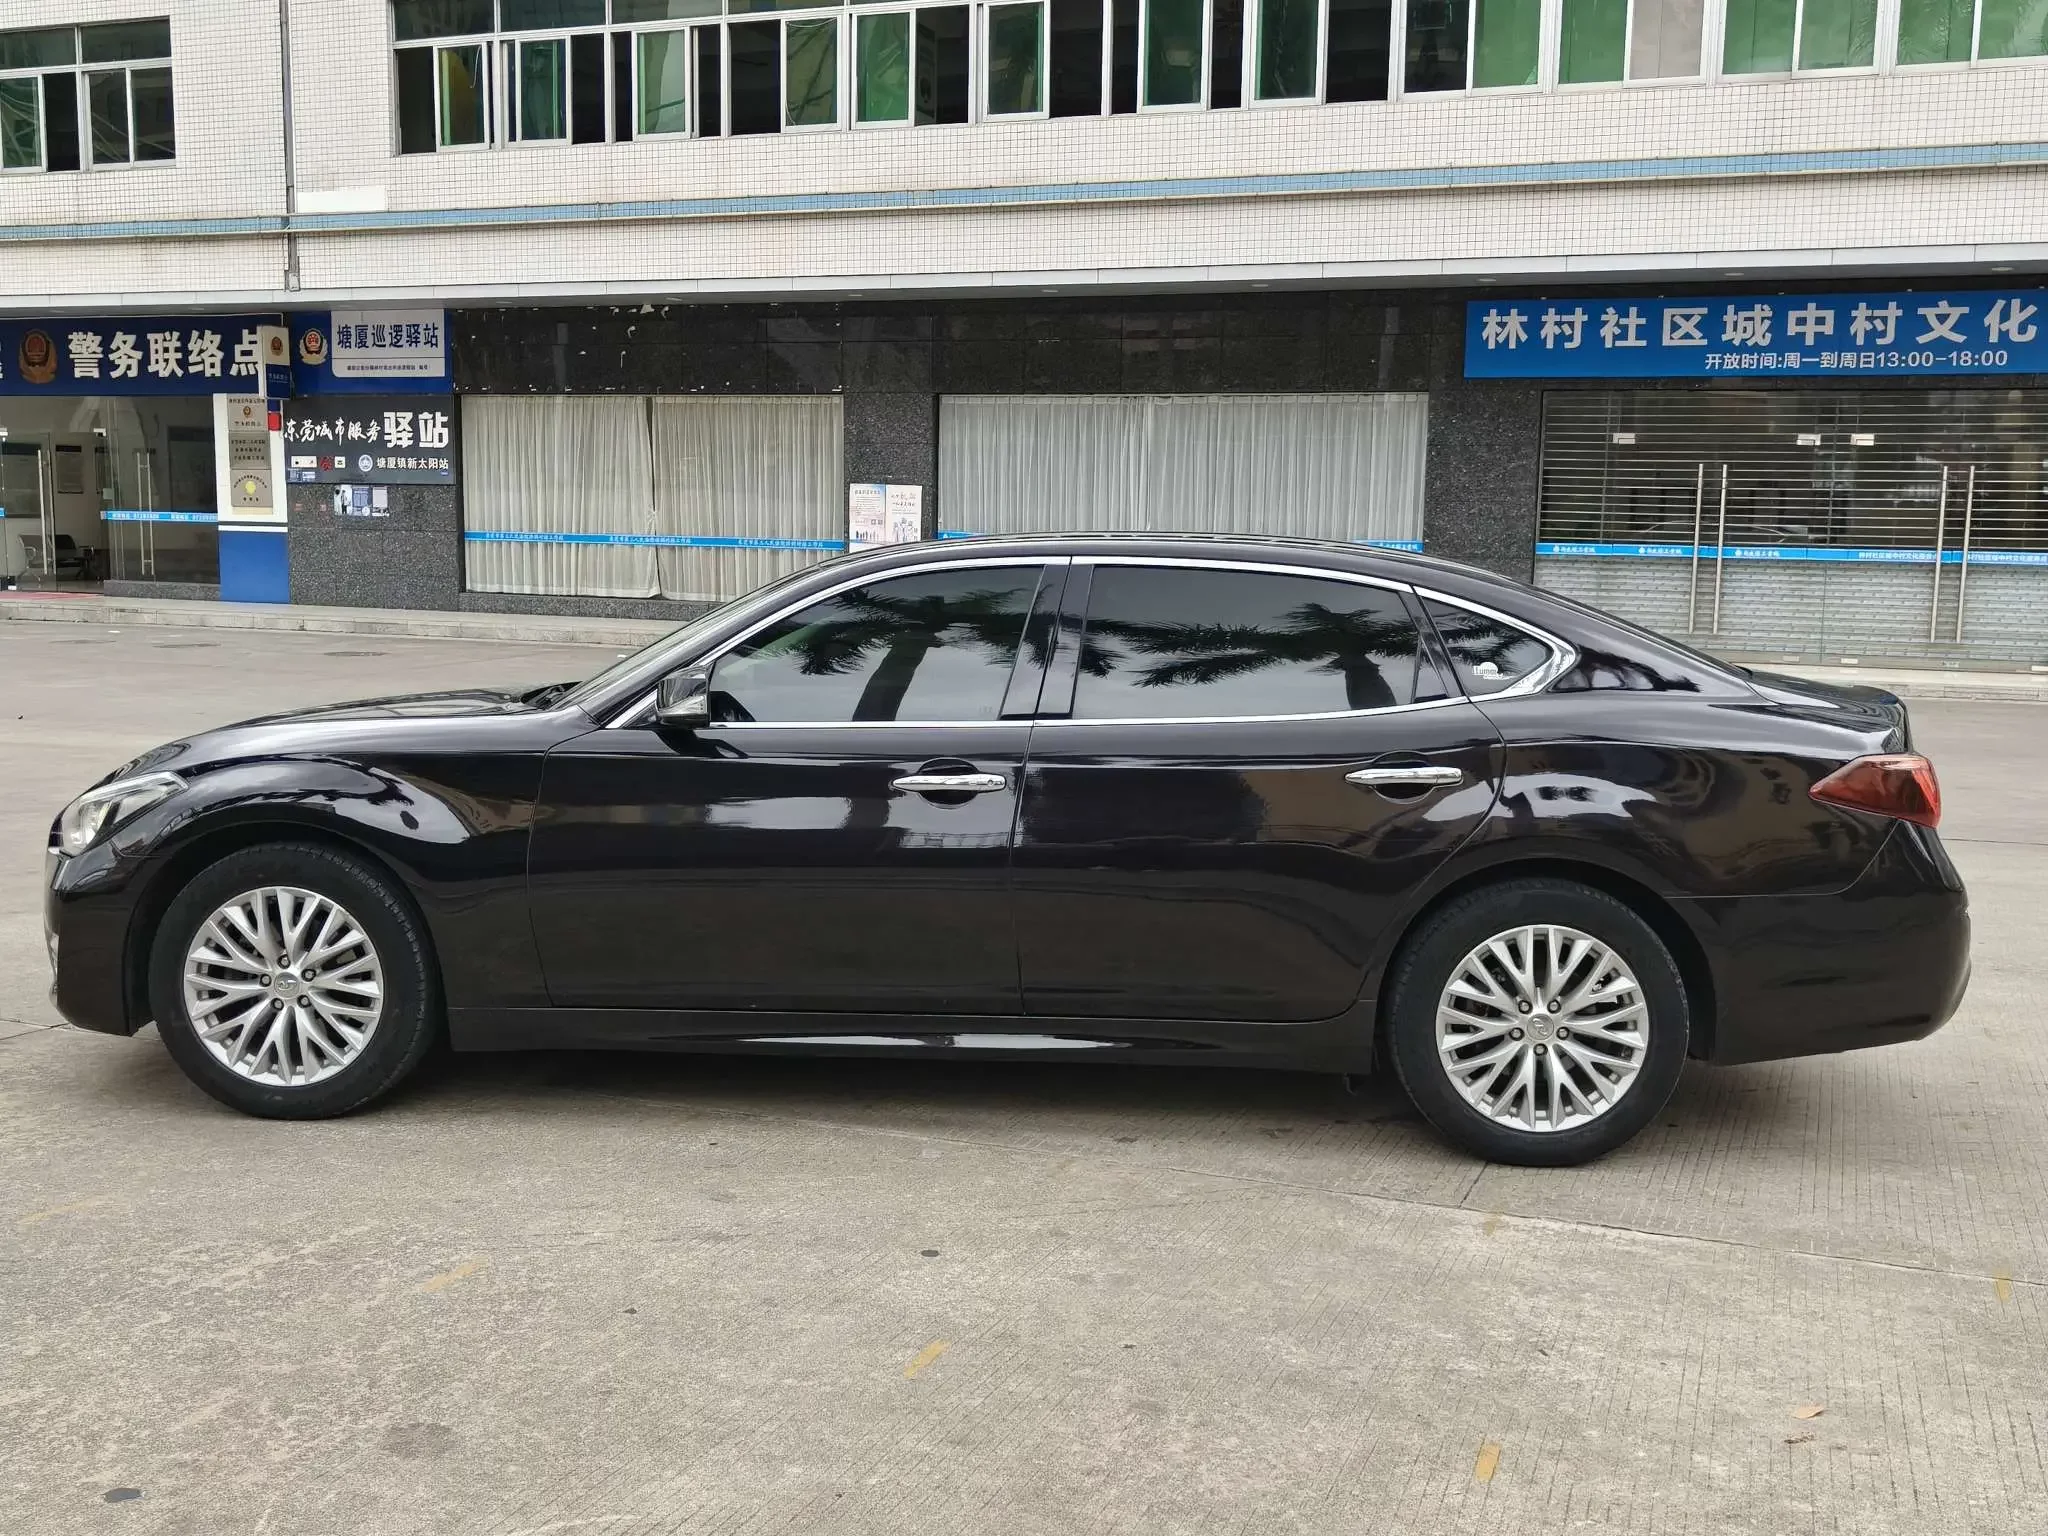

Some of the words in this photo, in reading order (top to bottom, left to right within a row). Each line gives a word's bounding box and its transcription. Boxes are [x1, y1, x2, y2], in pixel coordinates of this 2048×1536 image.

[336, 322, 439, 349] 塘厦巡逻驿站
[1481, 298, 2038, 350] 林村社区城中村文化
[67, 329, 258, 379] 警务联络点
[284, 411, 449, 448] 东莞城市服务驿站
[376, 455, 449, 469] 塘厦镇新太阳站
